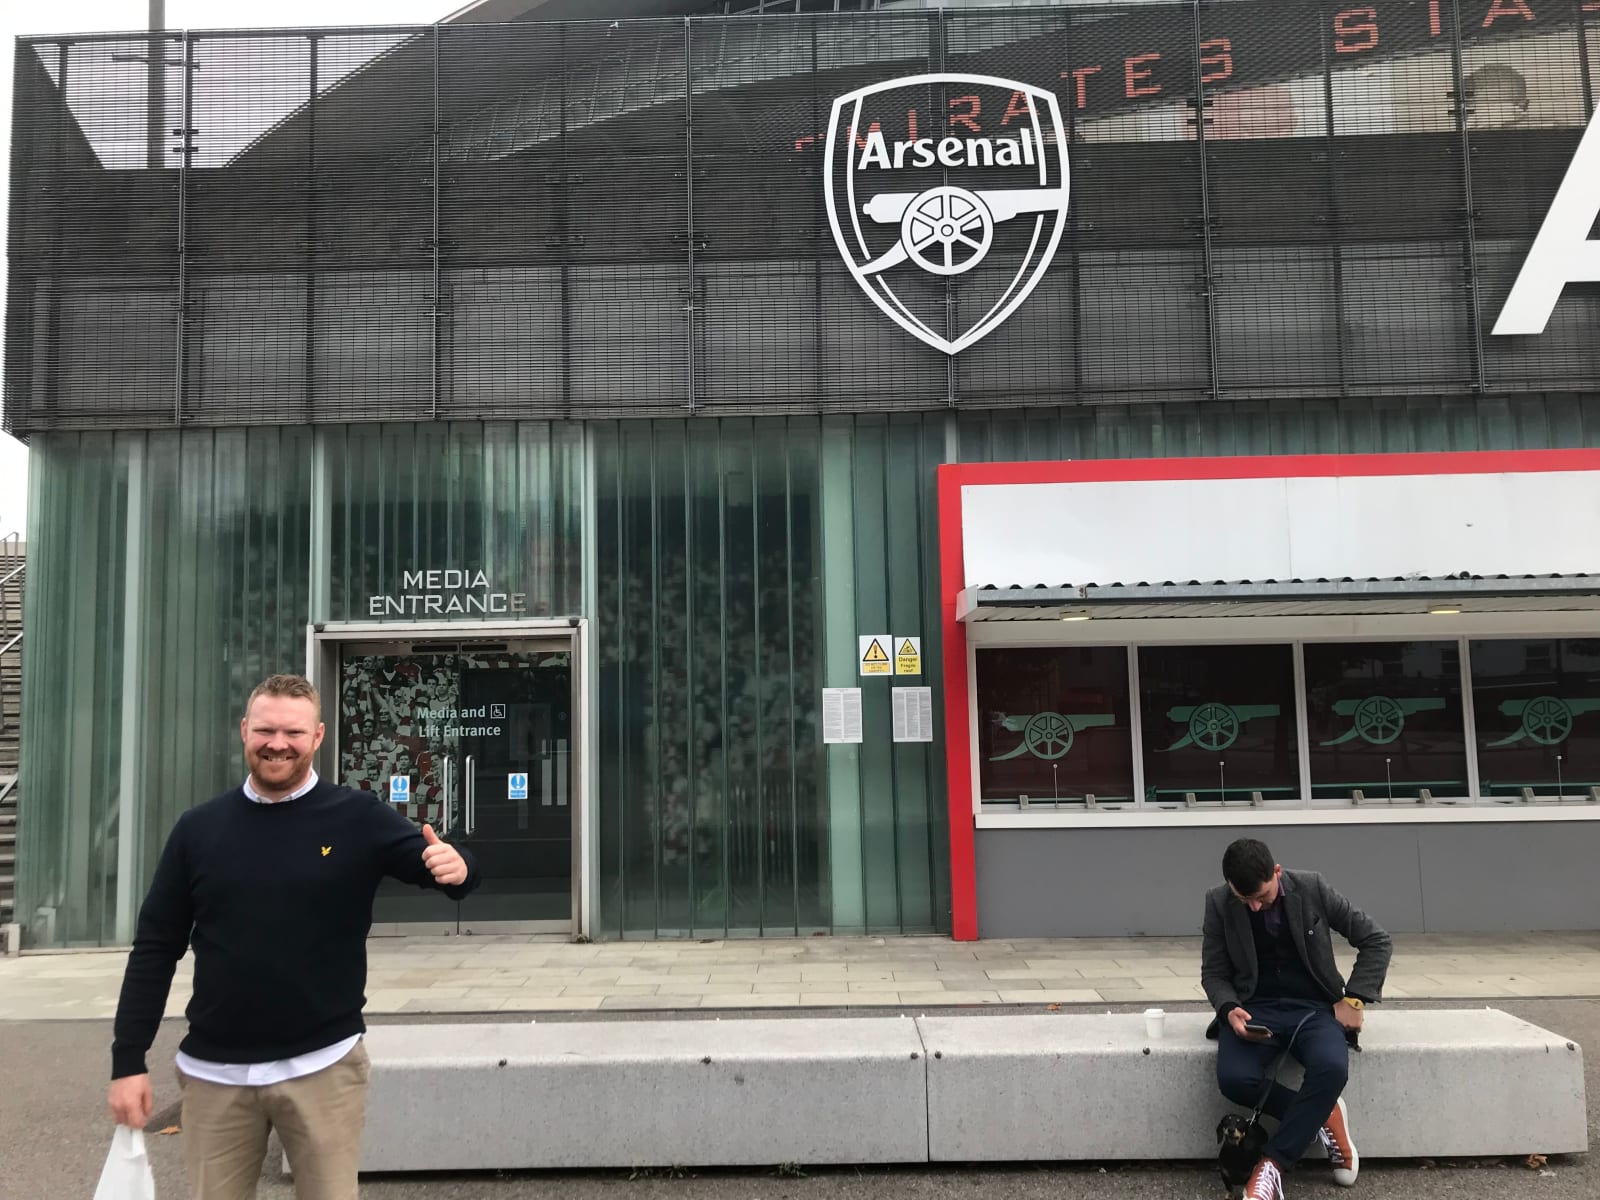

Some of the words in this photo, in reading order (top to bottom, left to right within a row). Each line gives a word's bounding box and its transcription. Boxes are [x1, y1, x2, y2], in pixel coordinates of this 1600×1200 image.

[857, 127, 1035, 170] Arsenal
[403, 569, 490, 590] MEDIA
[369, 593, 527, 616] ENTRANCE
[417, 706, 458, 719] Media
[461, 705, 486, 718] and
[418, 725, 440, 738] Lift
[444, 725, 501, 737] Entrance
